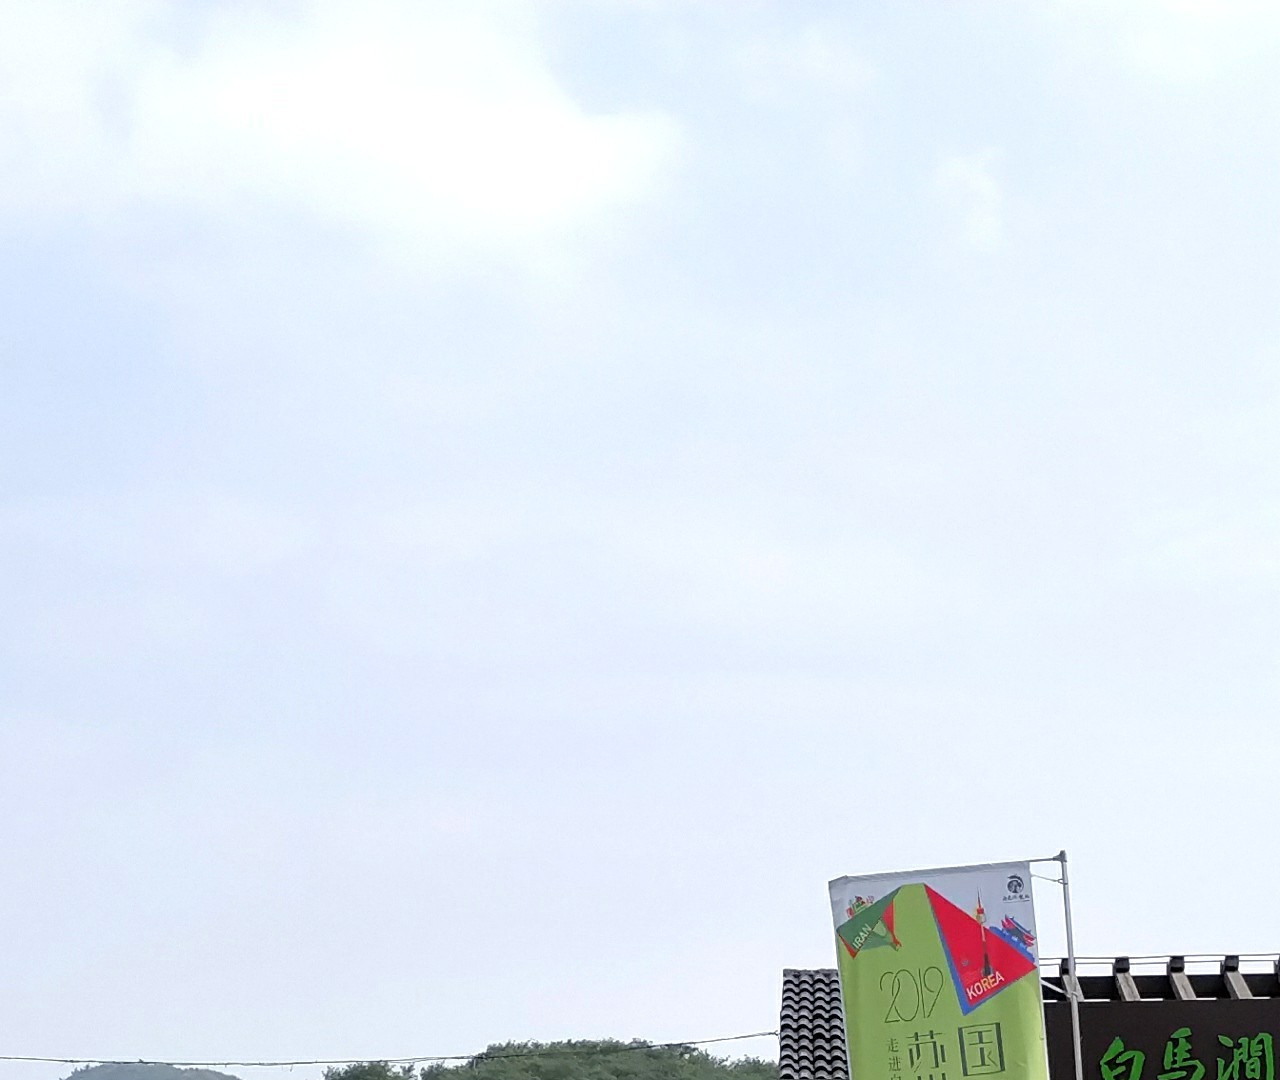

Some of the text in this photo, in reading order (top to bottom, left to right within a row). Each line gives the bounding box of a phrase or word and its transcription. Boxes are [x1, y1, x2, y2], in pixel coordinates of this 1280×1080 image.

[852, 923, 873, 951] IRAN
[879, 966, 945, 1024] 2019
[966, 970, 1005, 1002] KOREA
